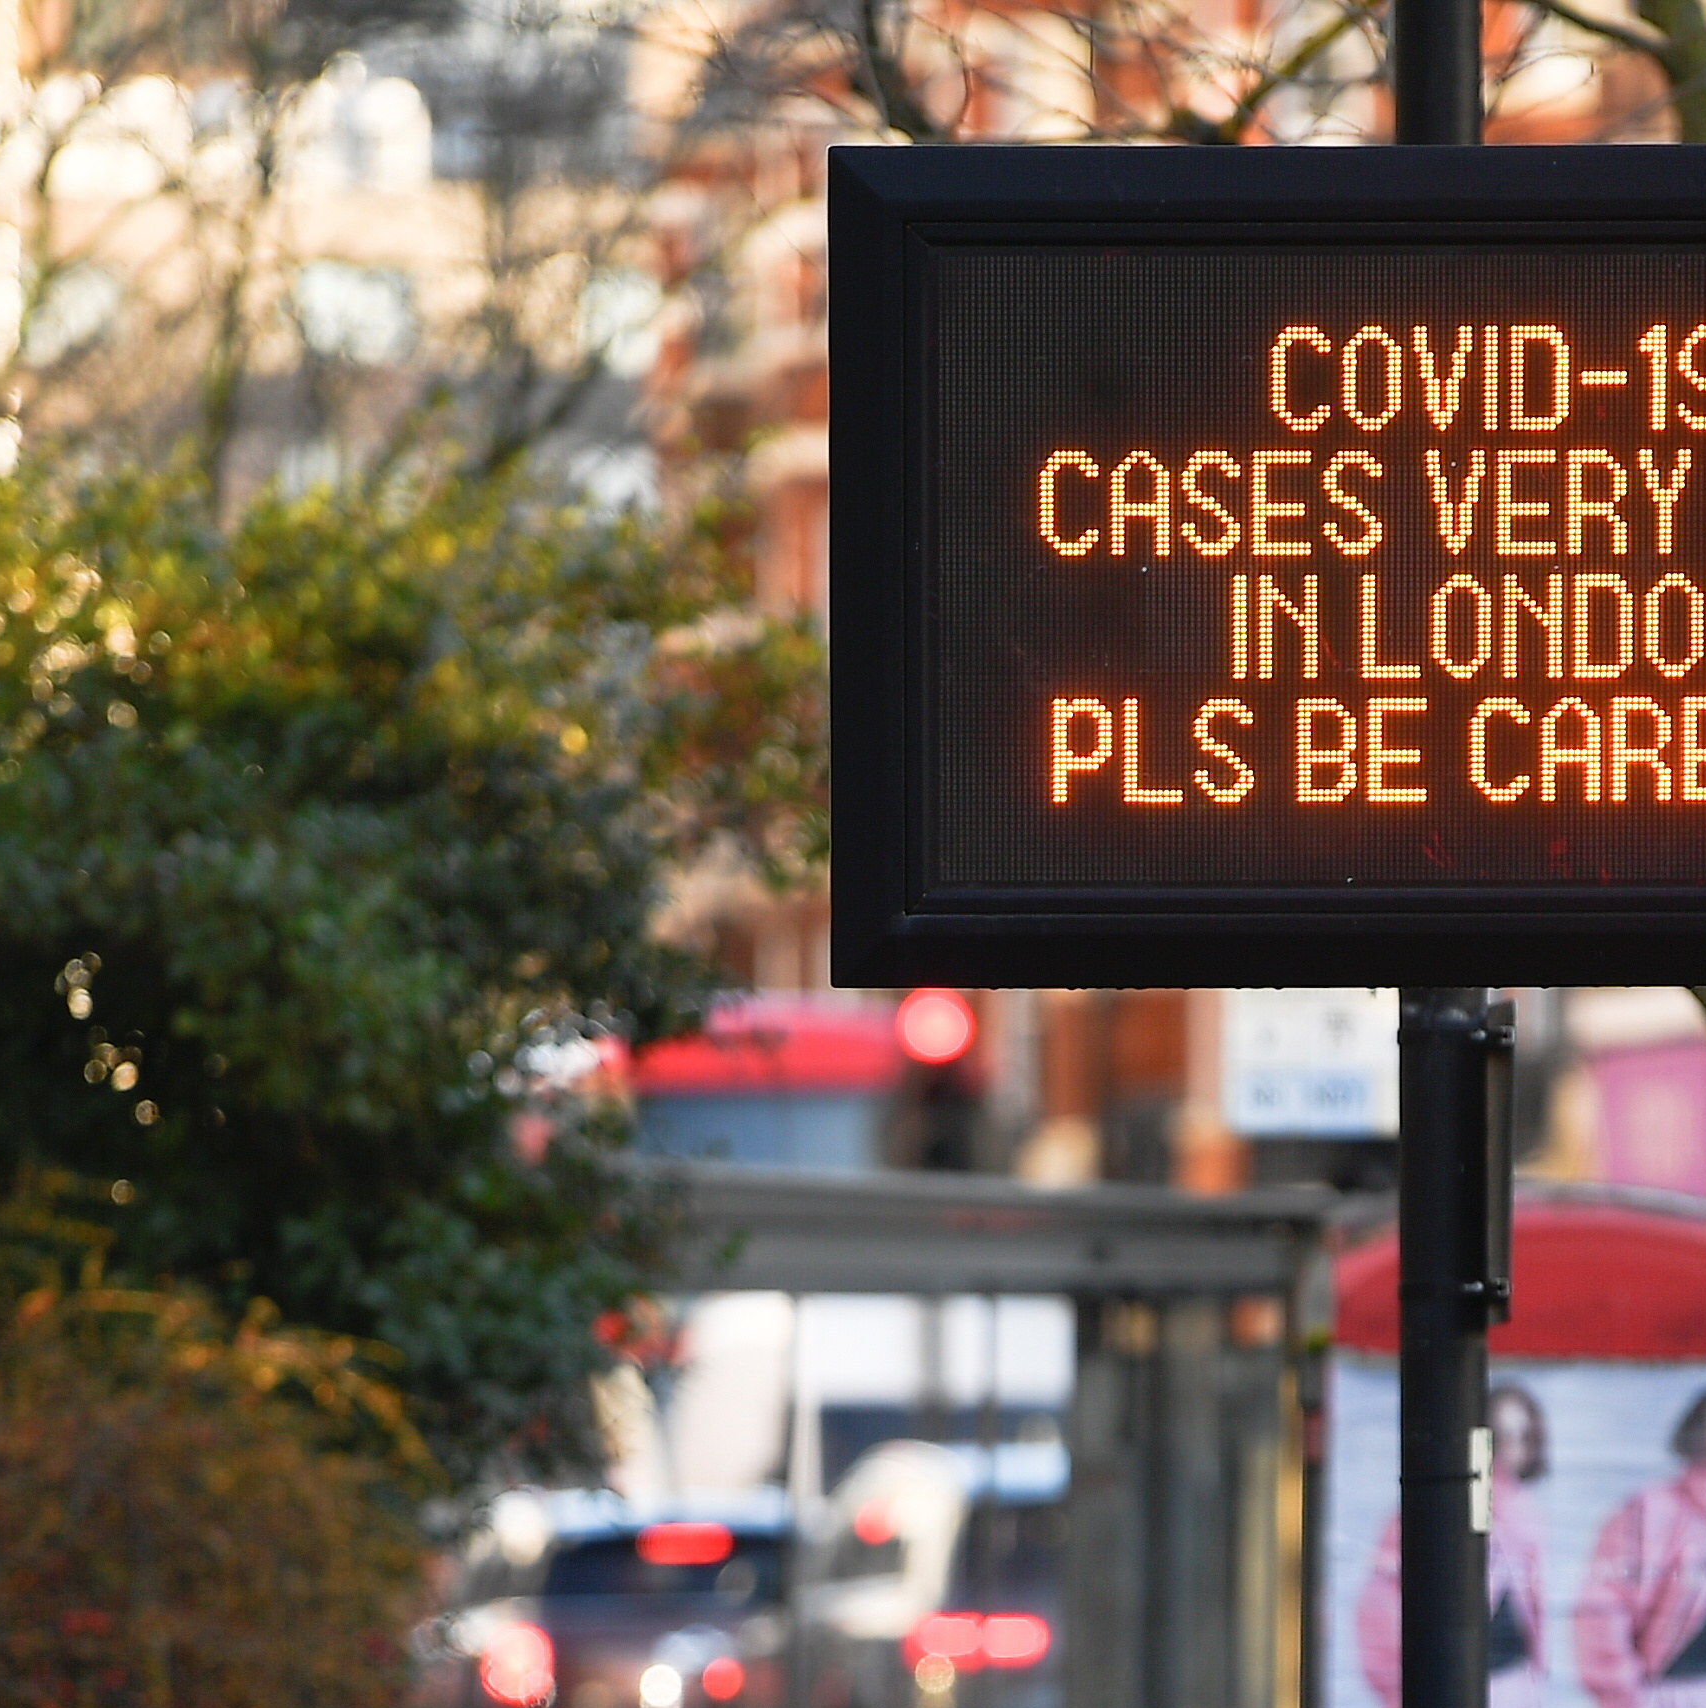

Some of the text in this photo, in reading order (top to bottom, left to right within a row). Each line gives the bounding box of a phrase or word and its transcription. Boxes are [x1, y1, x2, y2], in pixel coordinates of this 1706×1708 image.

[1037, 446, 1383, 557] CASES
[1423, 446, 1692, 557] VERY
[1229, 572, 1319, 680] IN
[1050, 695, 1255, 804] PLS
[1295, 694, 1429, 803] BE
